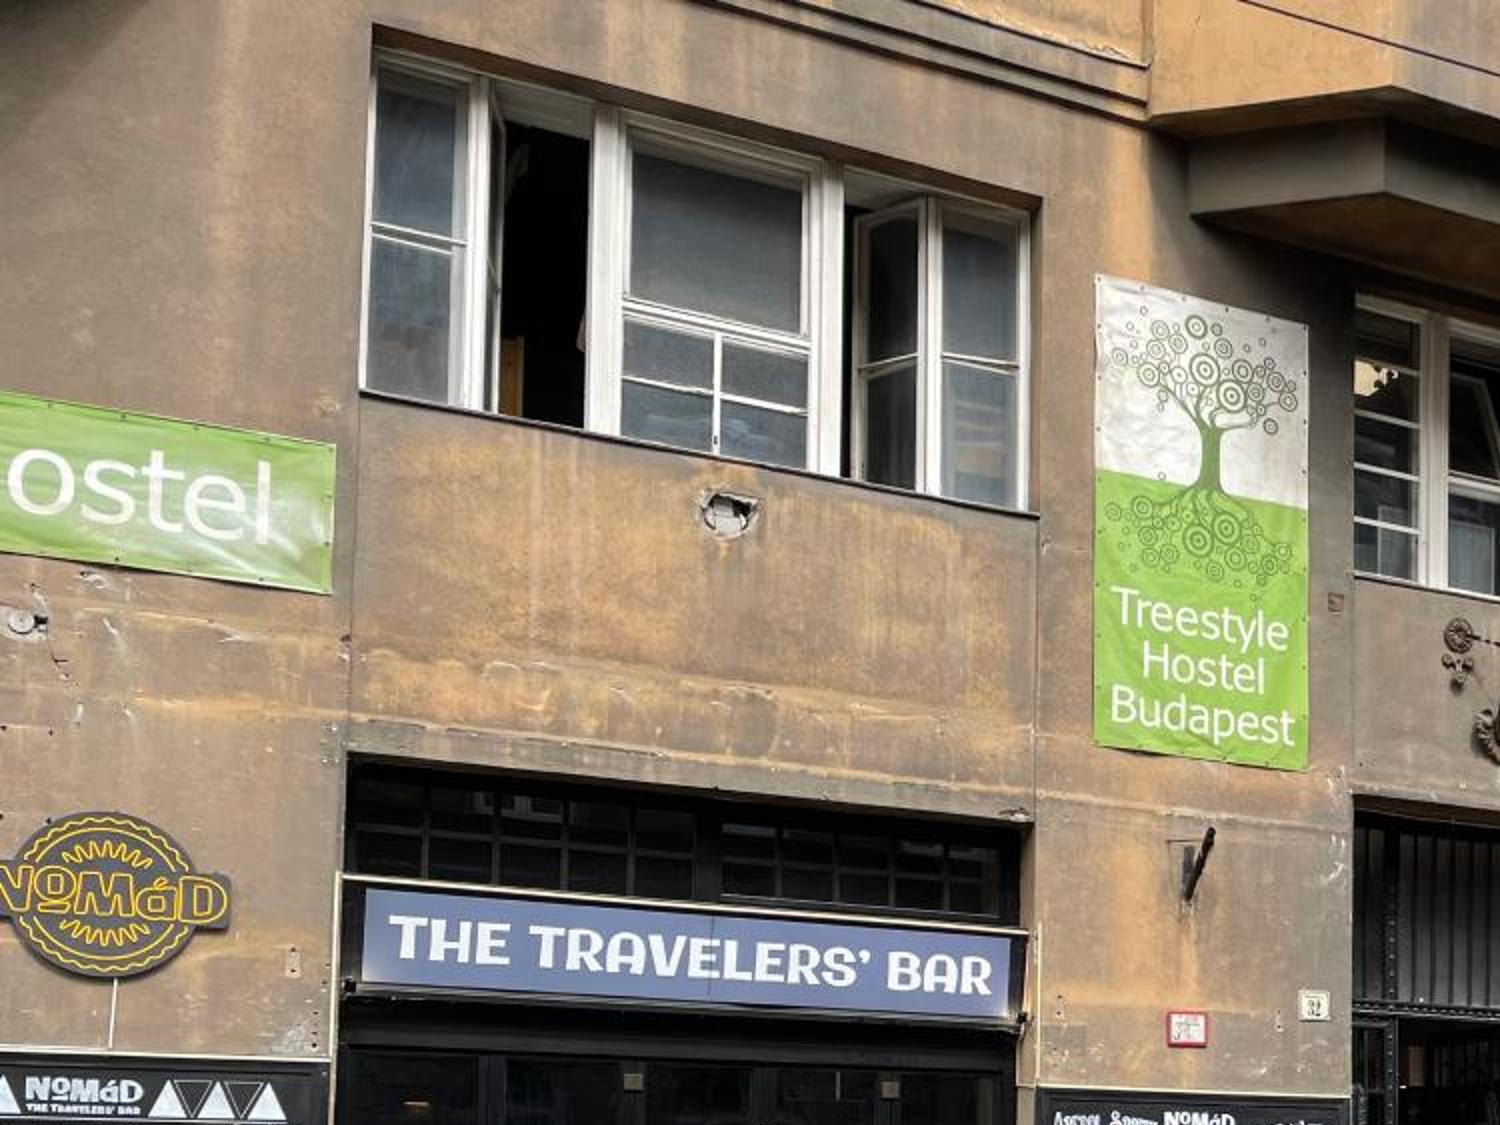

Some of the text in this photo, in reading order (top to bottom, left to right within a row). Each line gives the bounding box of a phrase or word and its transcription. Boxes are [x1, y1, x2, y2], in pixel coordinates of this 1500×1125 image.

[1111, 585, 1289, 653] Treestyle
[1143, 641, 1264, 695] Hostel
[1111, 684, 1296, 746] Budapest
[389, 916, 993, 996] THE TRAVELERS' BAR
[26, 1103, 48, 1112] THE
